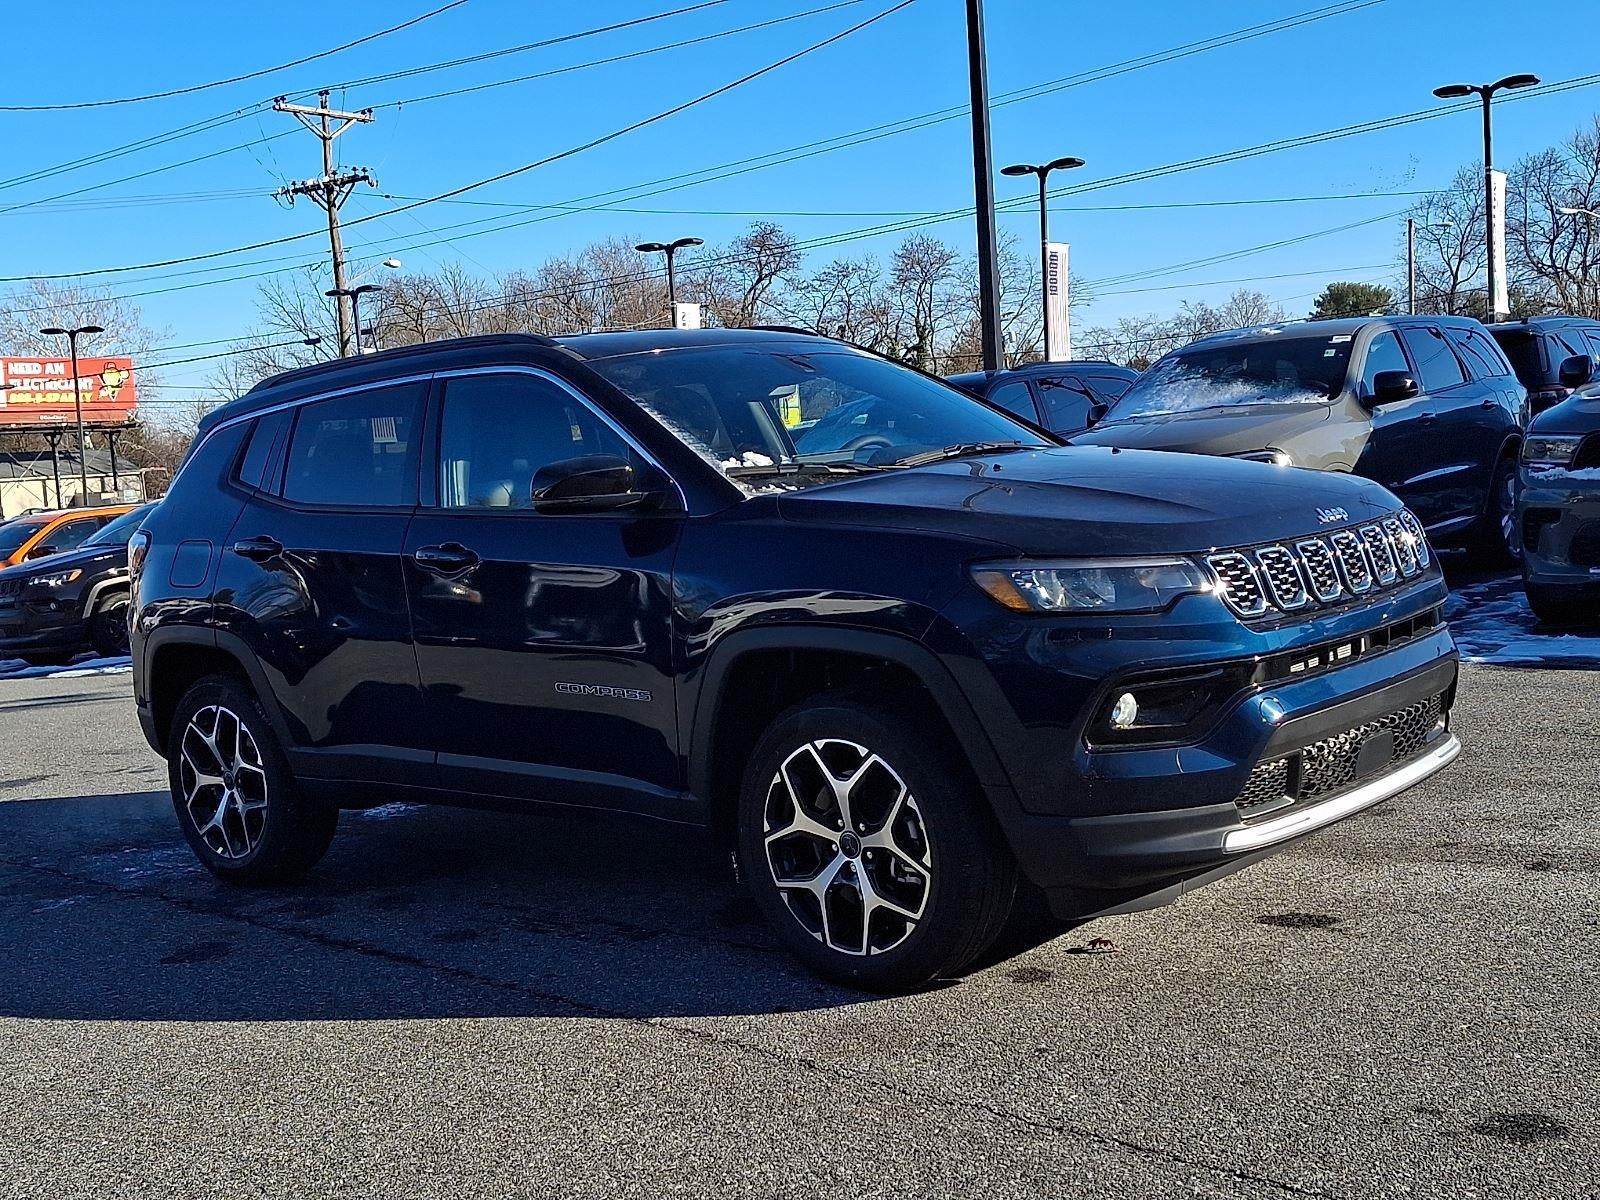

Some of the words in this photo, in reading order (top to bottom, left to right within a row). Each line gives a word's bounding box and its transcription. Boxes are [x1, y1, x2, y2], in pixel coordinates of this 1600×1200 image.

[7, 362, 42, 375] NEED
[44, 362, 65, 375] AN
[1315, 506, 1349, 525] Jeep
[554, 682, 653, 702] COMPASS
